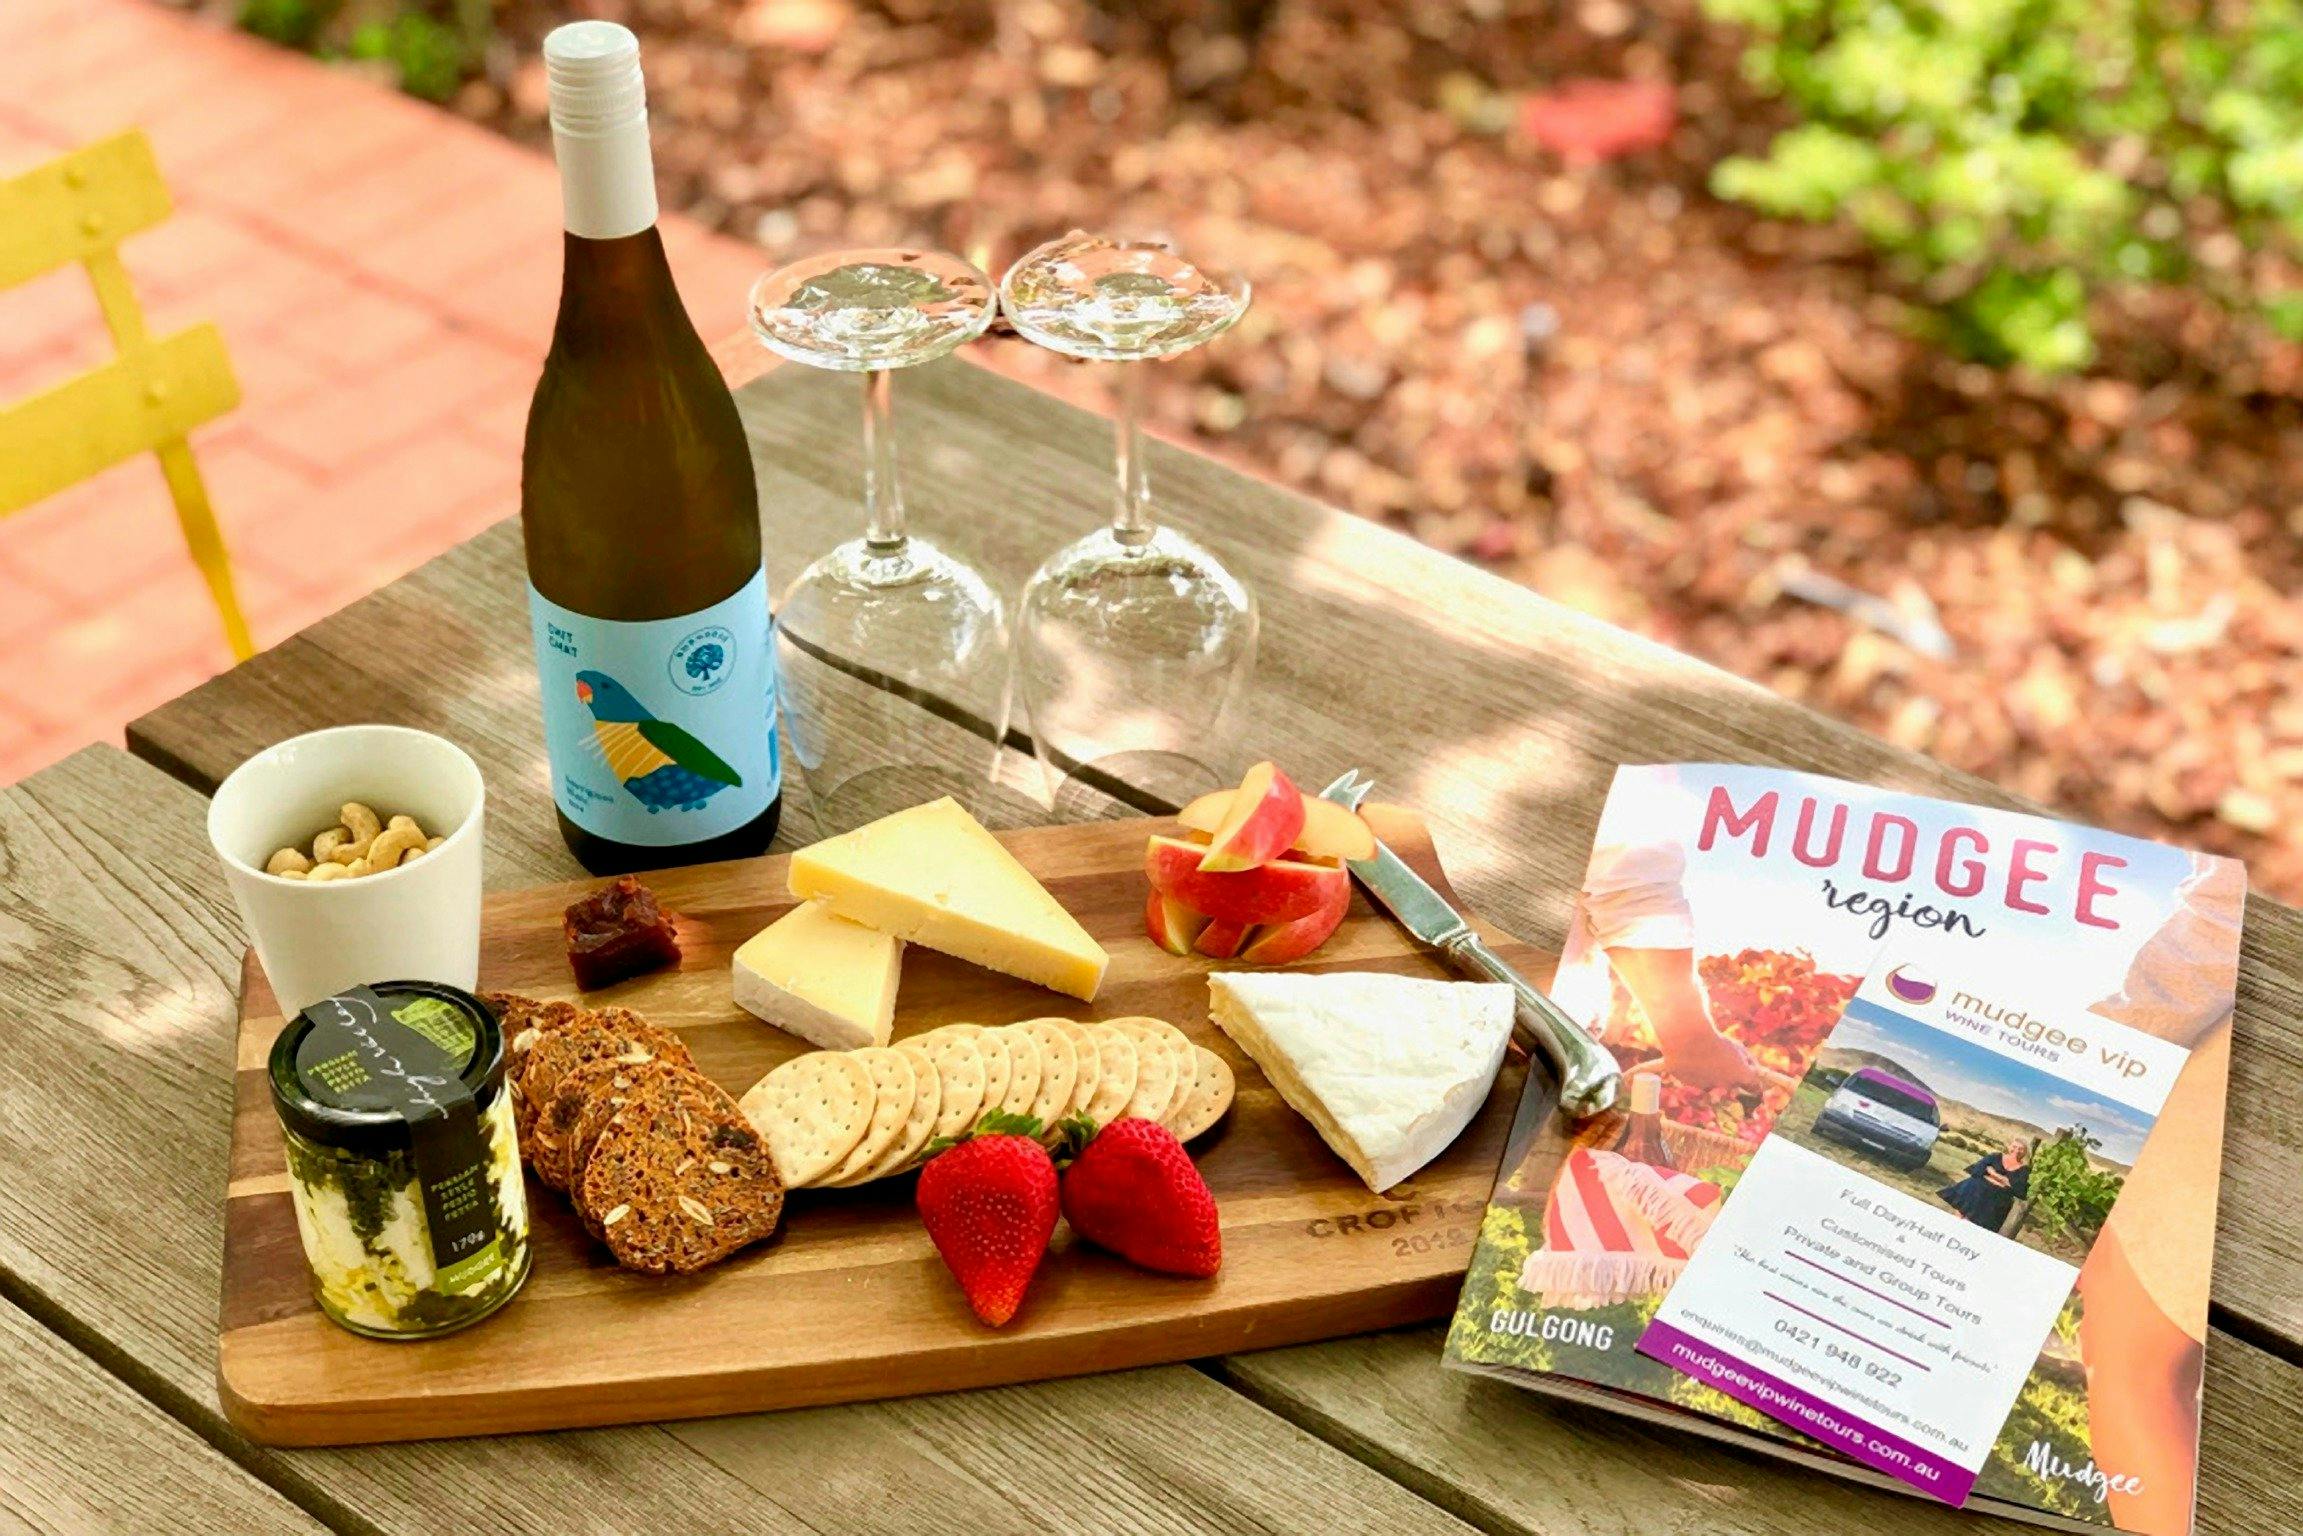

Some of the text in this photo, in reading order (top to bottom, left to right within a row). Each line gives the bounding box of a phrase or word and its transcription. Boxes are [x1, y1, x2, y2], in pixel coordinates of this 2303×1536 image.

[1697, 785, 2129, 931] MUDGEE
[1821, 878, 1987, 940] region
[1945, 1009, 2061, 1063] WINE TOURS
[1951, 991, 2148, 1078] mudgee vip
[1839, 1188, 1982, 1261] Full Day/Half Day
[1784, 1225, 1983, 1326] Private and Group Tours
[1920, 1262, 1967, 1292] Tours
[1490, 1309, 1615, 1351] GULGONG
[1774, 1318, 1821, 1350] 0421
[1864, 1361, 1903, 1388] 922
[1671, 1342, 1942, 1482] mudgeevipwinetours.com.au
[2024, 1440, 2146, 1504] Mudgee
